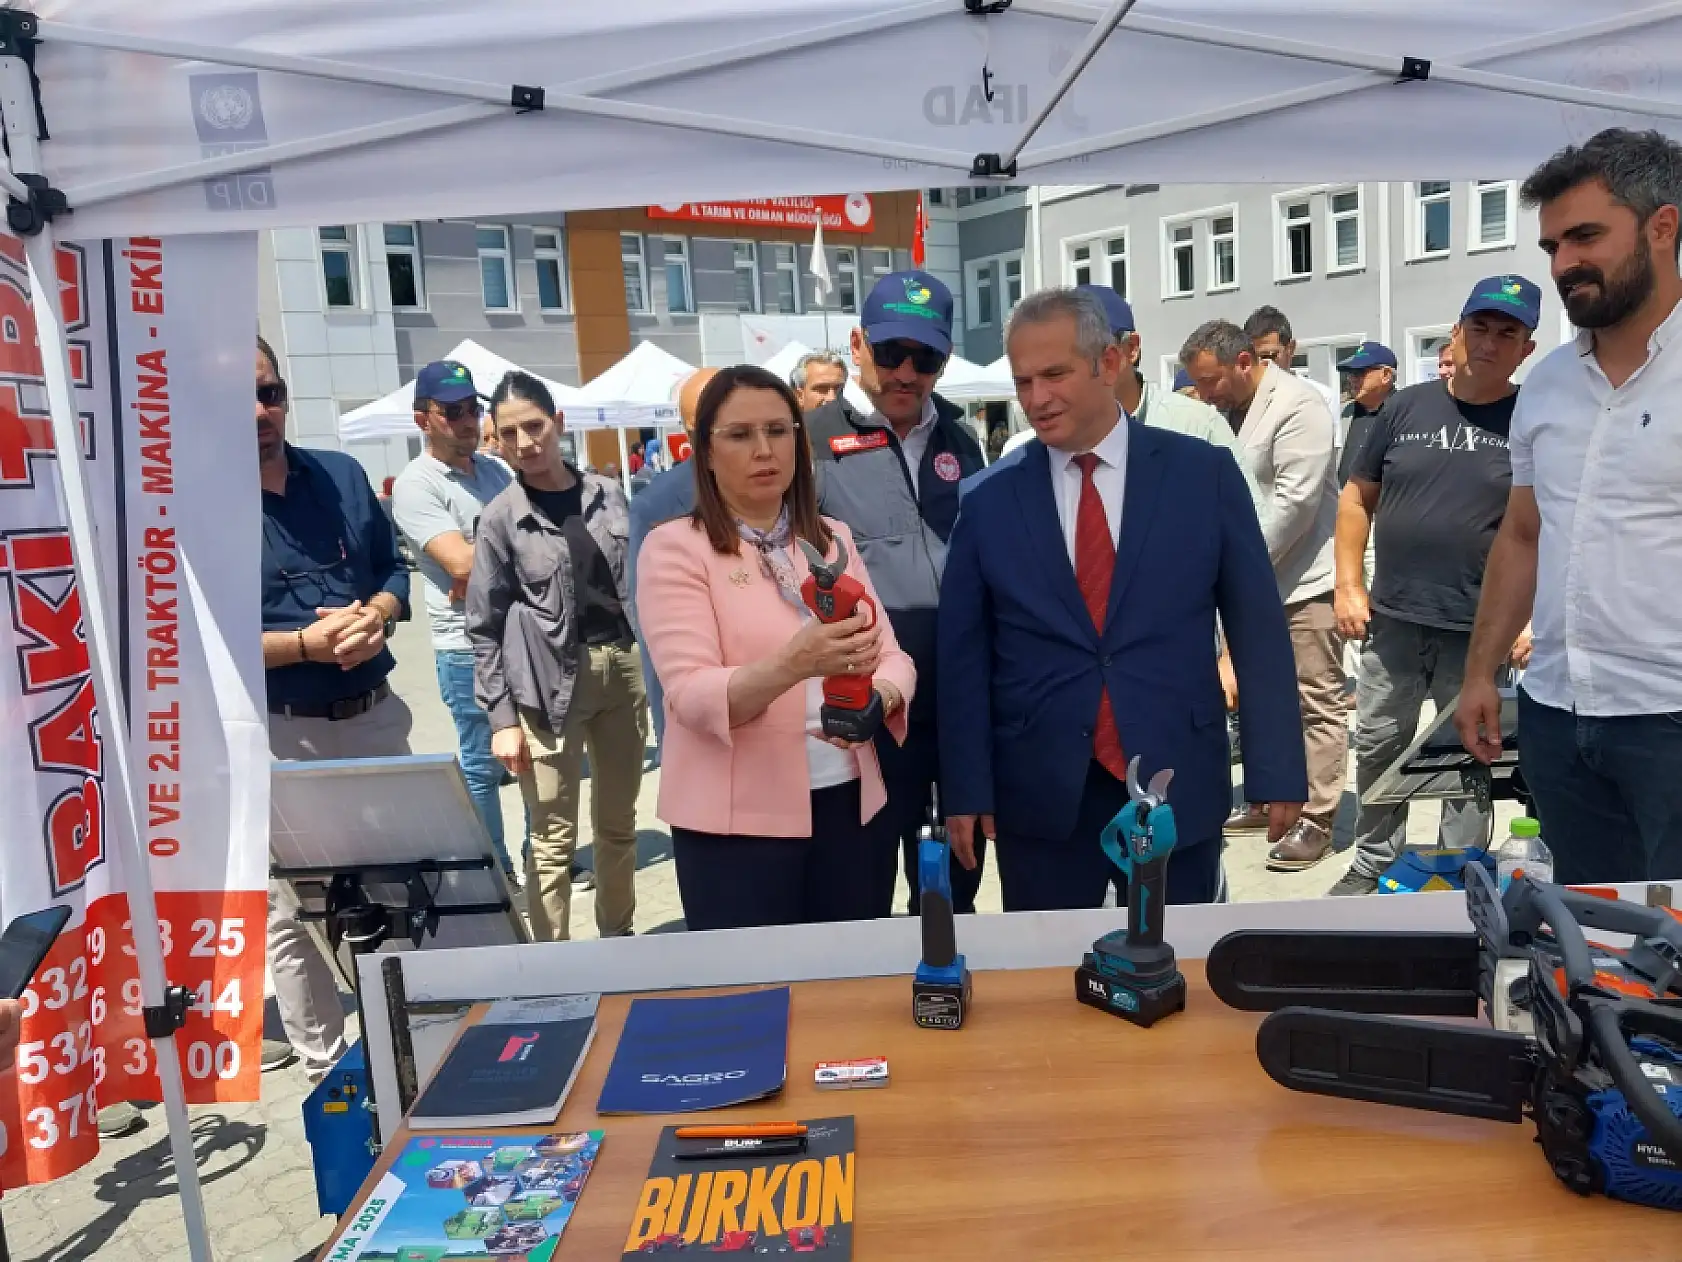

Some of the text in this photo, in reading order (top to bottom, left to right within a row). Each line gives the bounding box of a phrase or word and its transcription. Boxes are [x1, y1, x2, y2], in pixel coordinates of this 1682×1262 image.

[702, 204, 732, 218] TARIM
[733, 207, 747, 219] VE
[748, 208, 784, 222] ORMAN
[131, 350, 174, 494] MAKİNA
[138, 526, 180, 690] TRAKTÖR
[148, 701, 180, 771] 2.EL
[149, 783, 180, 828] VE
[189, 917, 246, 957] 25
[18, 1020, 94, 1085] 532
[187, 978, 243, 1018] 44
[26, 1082, 98, 1149] 378
[187, 1040, 242, 1079] 00
[641, 1069, 748, 1084] SAGRO
[352, 1198, 388, 1231] 2025
[623, 1151, 855, 1252] BURKON
